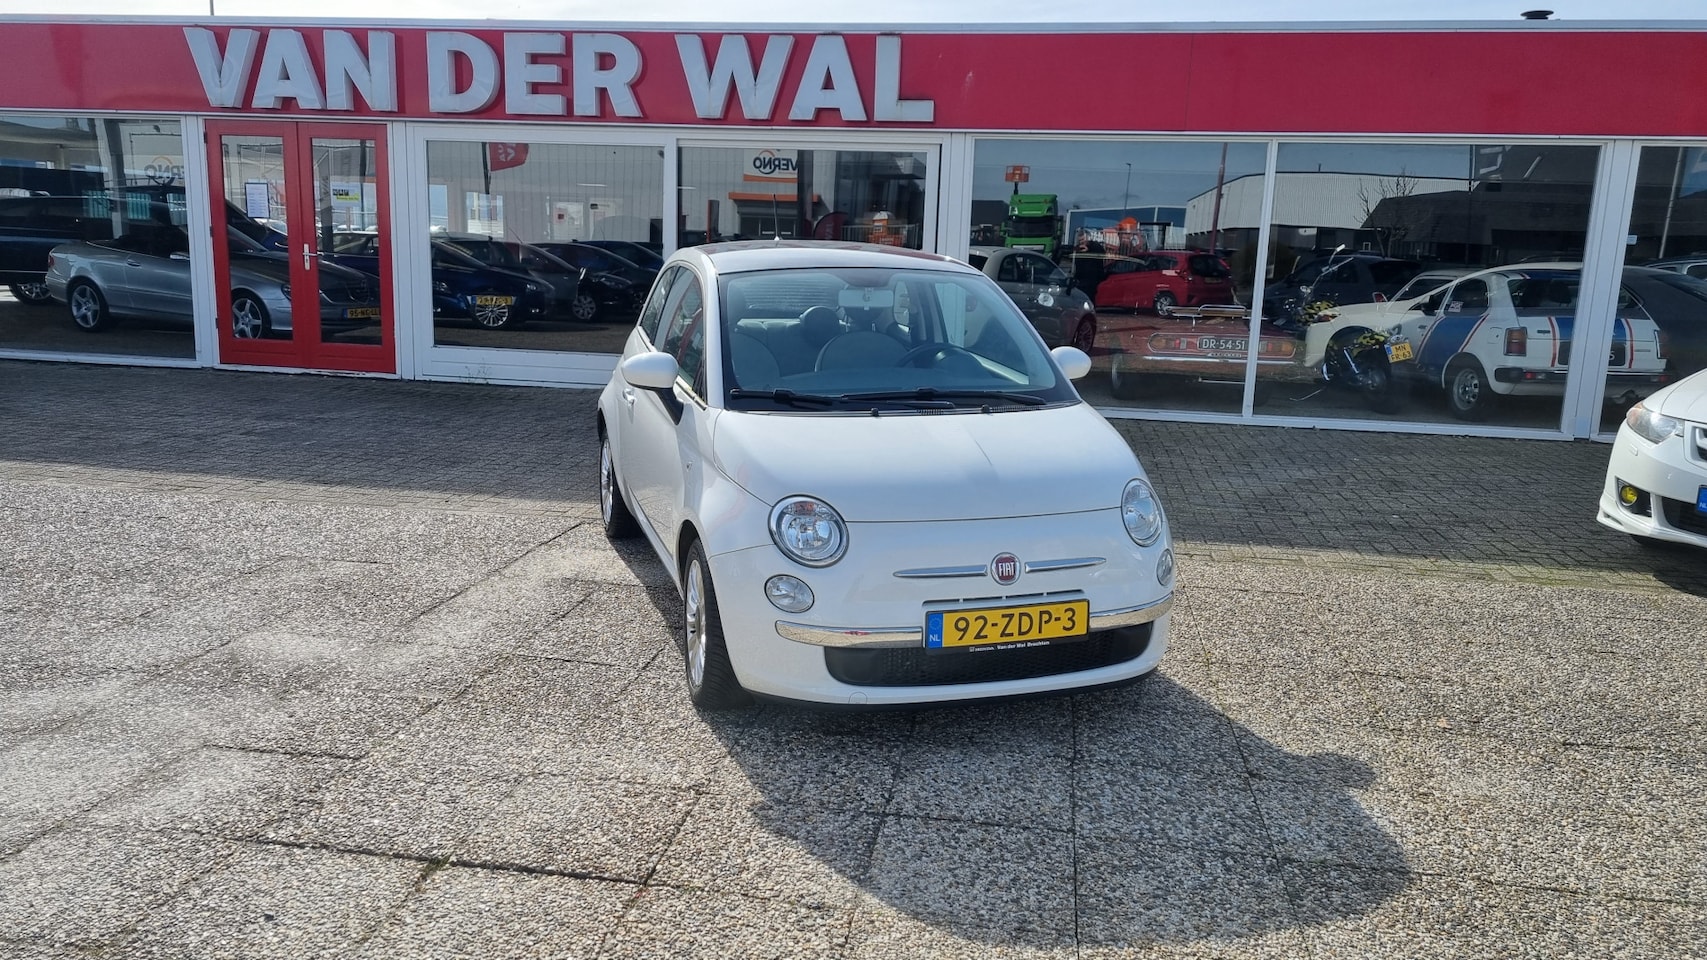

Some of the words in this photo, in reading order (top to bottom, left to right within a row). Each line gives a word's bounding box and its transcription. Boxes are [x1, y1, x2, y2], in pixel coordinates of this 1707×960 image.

[183, 26, 397, 112] VAN
[426, 31, 643, 118] DER
[674, 33, 935, 122] WAL
[998, 562, 1014, 577] FIAT
[954, 607, 1076, 641] 92-ZDP-3
[929, 633, 941, 642] NL
